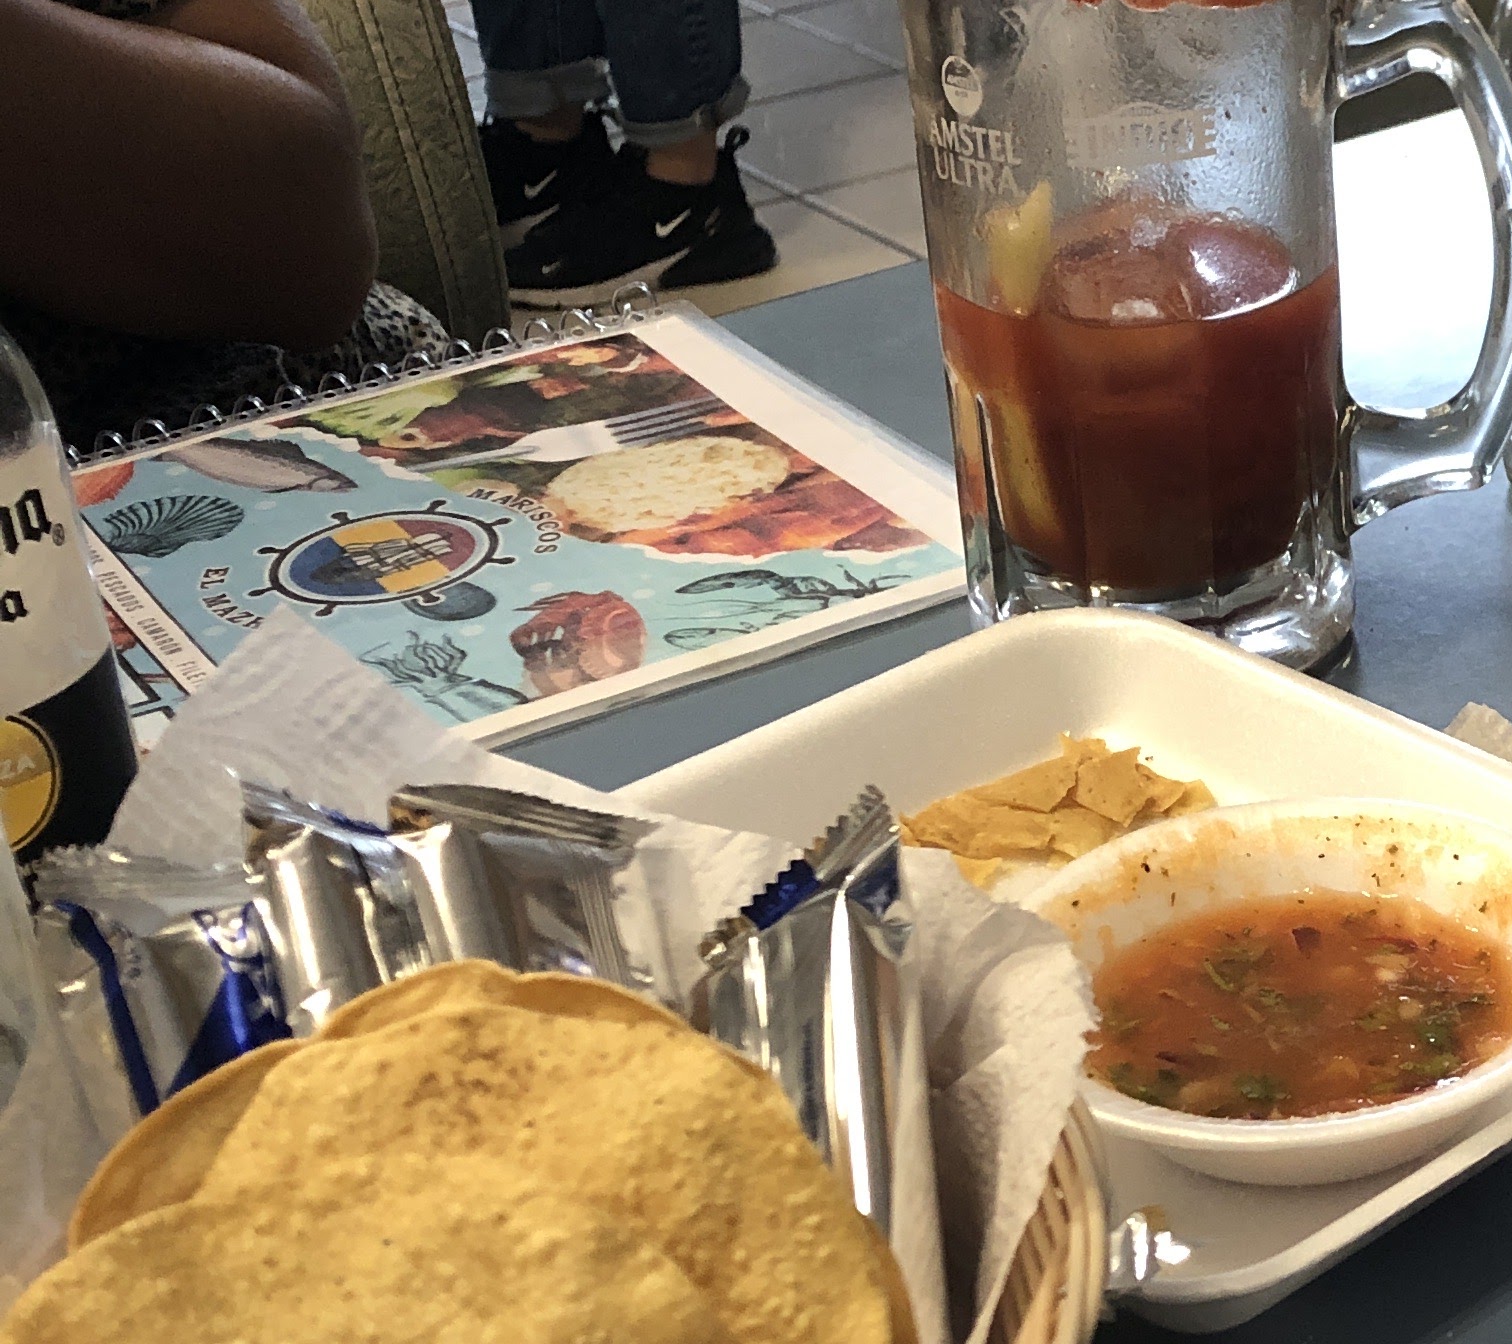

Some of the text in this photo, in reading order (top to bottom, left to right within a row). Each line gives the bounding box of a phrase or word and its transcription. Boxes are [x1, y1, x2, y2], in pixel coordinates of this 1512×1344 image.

[929, 116, 1022, 166] AMSTEL
[933, 145, 1020, 198] ULTRA
[465, 488, 562, 554] MARISCOS
[98, 571, 145, 613] PESCADOS
[199, 567, 230, 590] EL
